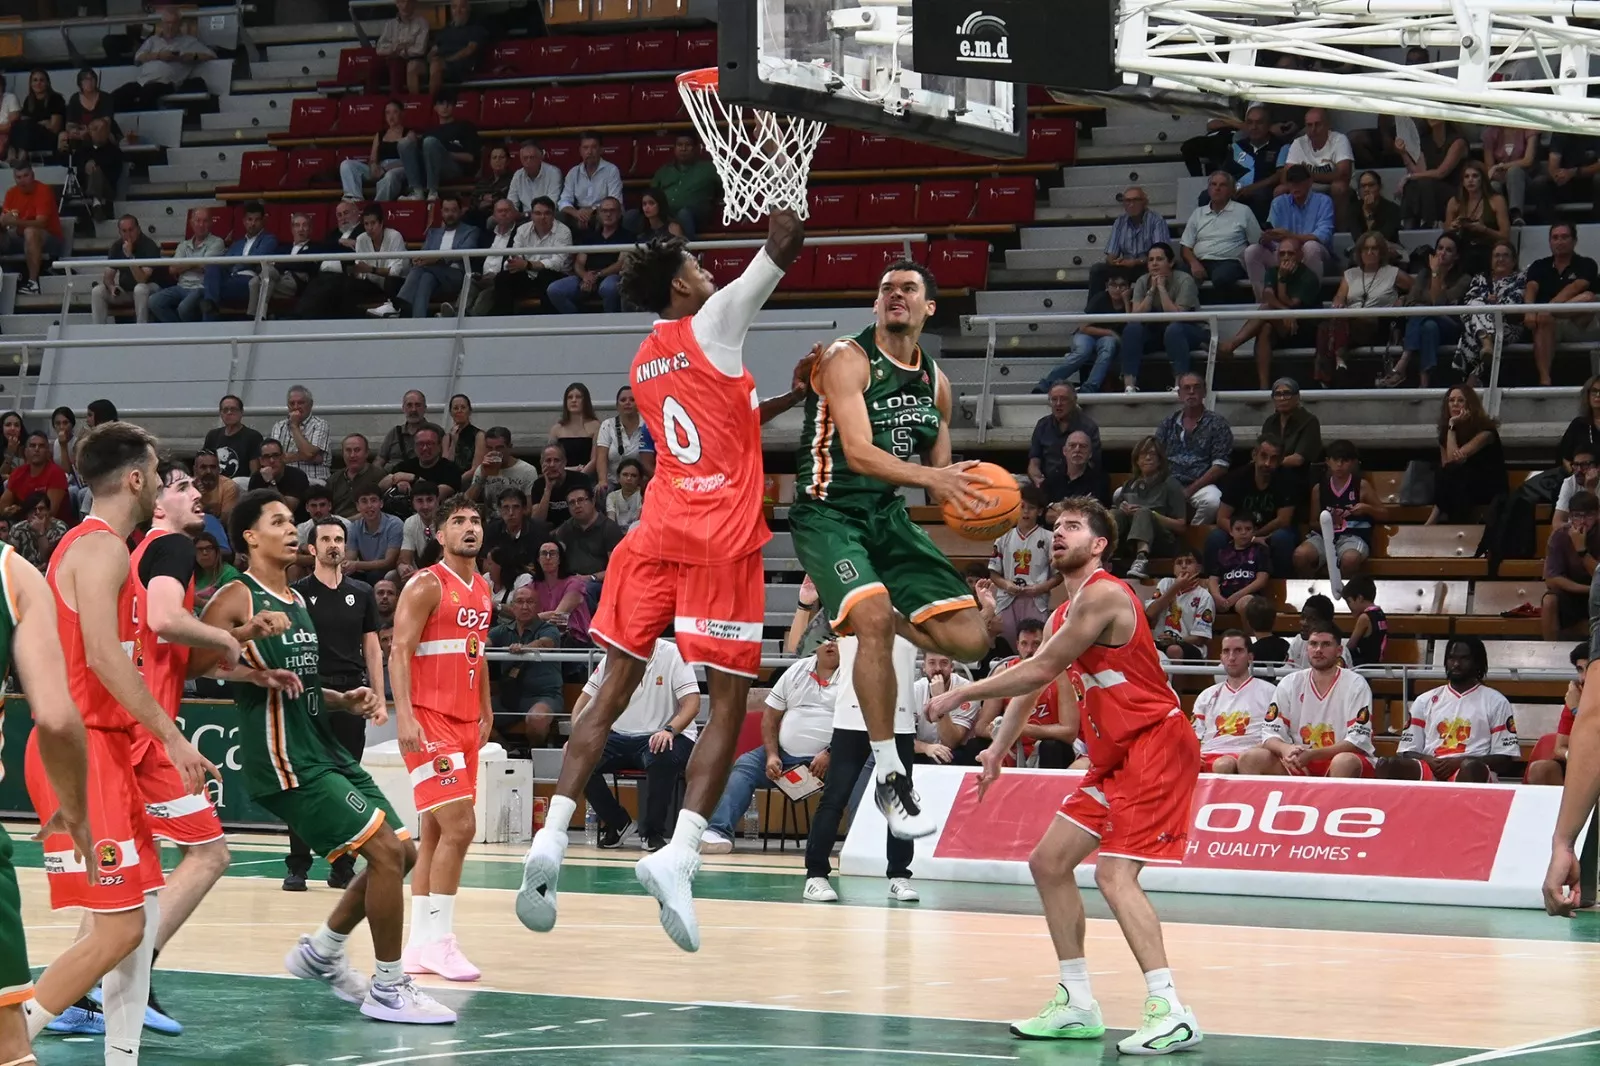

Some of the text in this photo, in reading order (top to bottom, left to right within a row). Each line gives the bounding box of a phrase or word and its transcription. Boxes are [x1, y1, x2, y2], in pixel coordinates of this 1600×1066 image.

[960, 36, 1009, 58] e.m.d
[636, 351, 690, 383] KNOWES
[662, 395, 702, 465] 0
[834, 558, 859, 584] 9
[456, 606, 490, 630] CBZ
[281, 628, 319, 645] Lobe
[346, 790, 368, 814] 0
[1194, 790, 1386, 838] obe
[1207, 841, 1282, 858] QUALITY
[1288, 845, 1351, 861] HOMES
